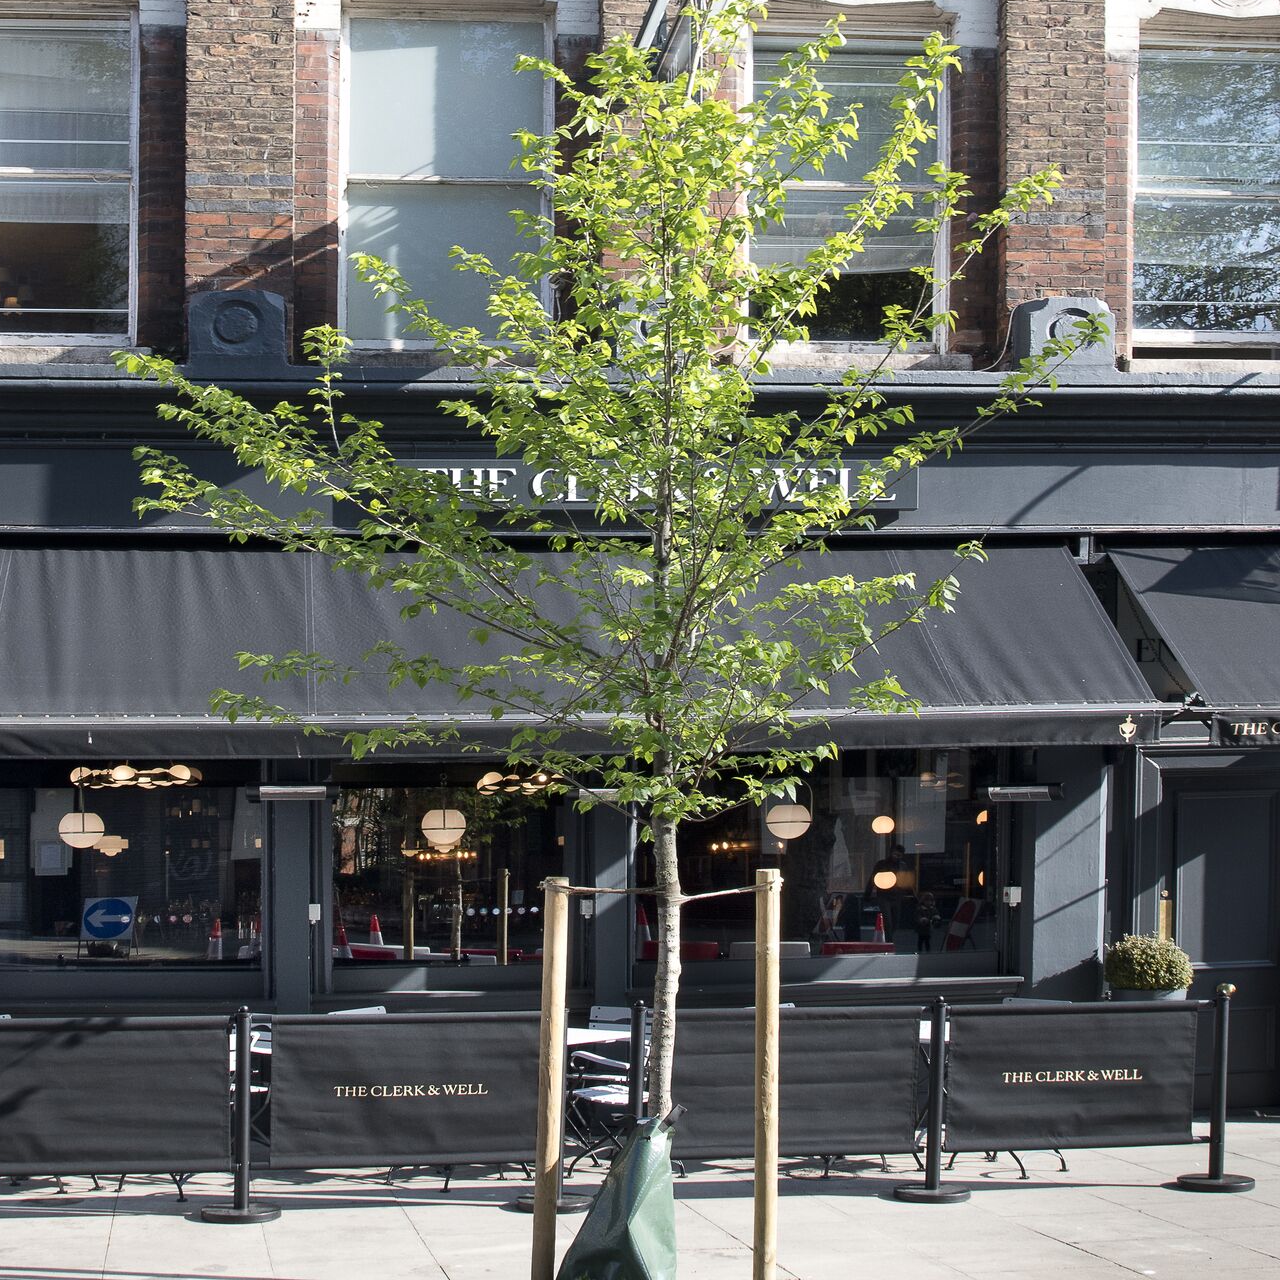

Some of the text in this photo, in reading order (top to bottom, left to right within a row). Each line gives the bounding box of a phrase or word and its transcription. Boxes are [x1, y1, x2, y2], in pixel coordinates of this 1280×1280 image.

[417, 467, 518, 502] THE
[531, 467, 689, 502] CLR
[749, 467, 897, 502] WELL
[1230, 722, 1269, 736] THE
[1002, 1068, 1143, 1083] THE CLERK & WELL
[333, 1083, 489, 1097] THE CLERK & WELL
